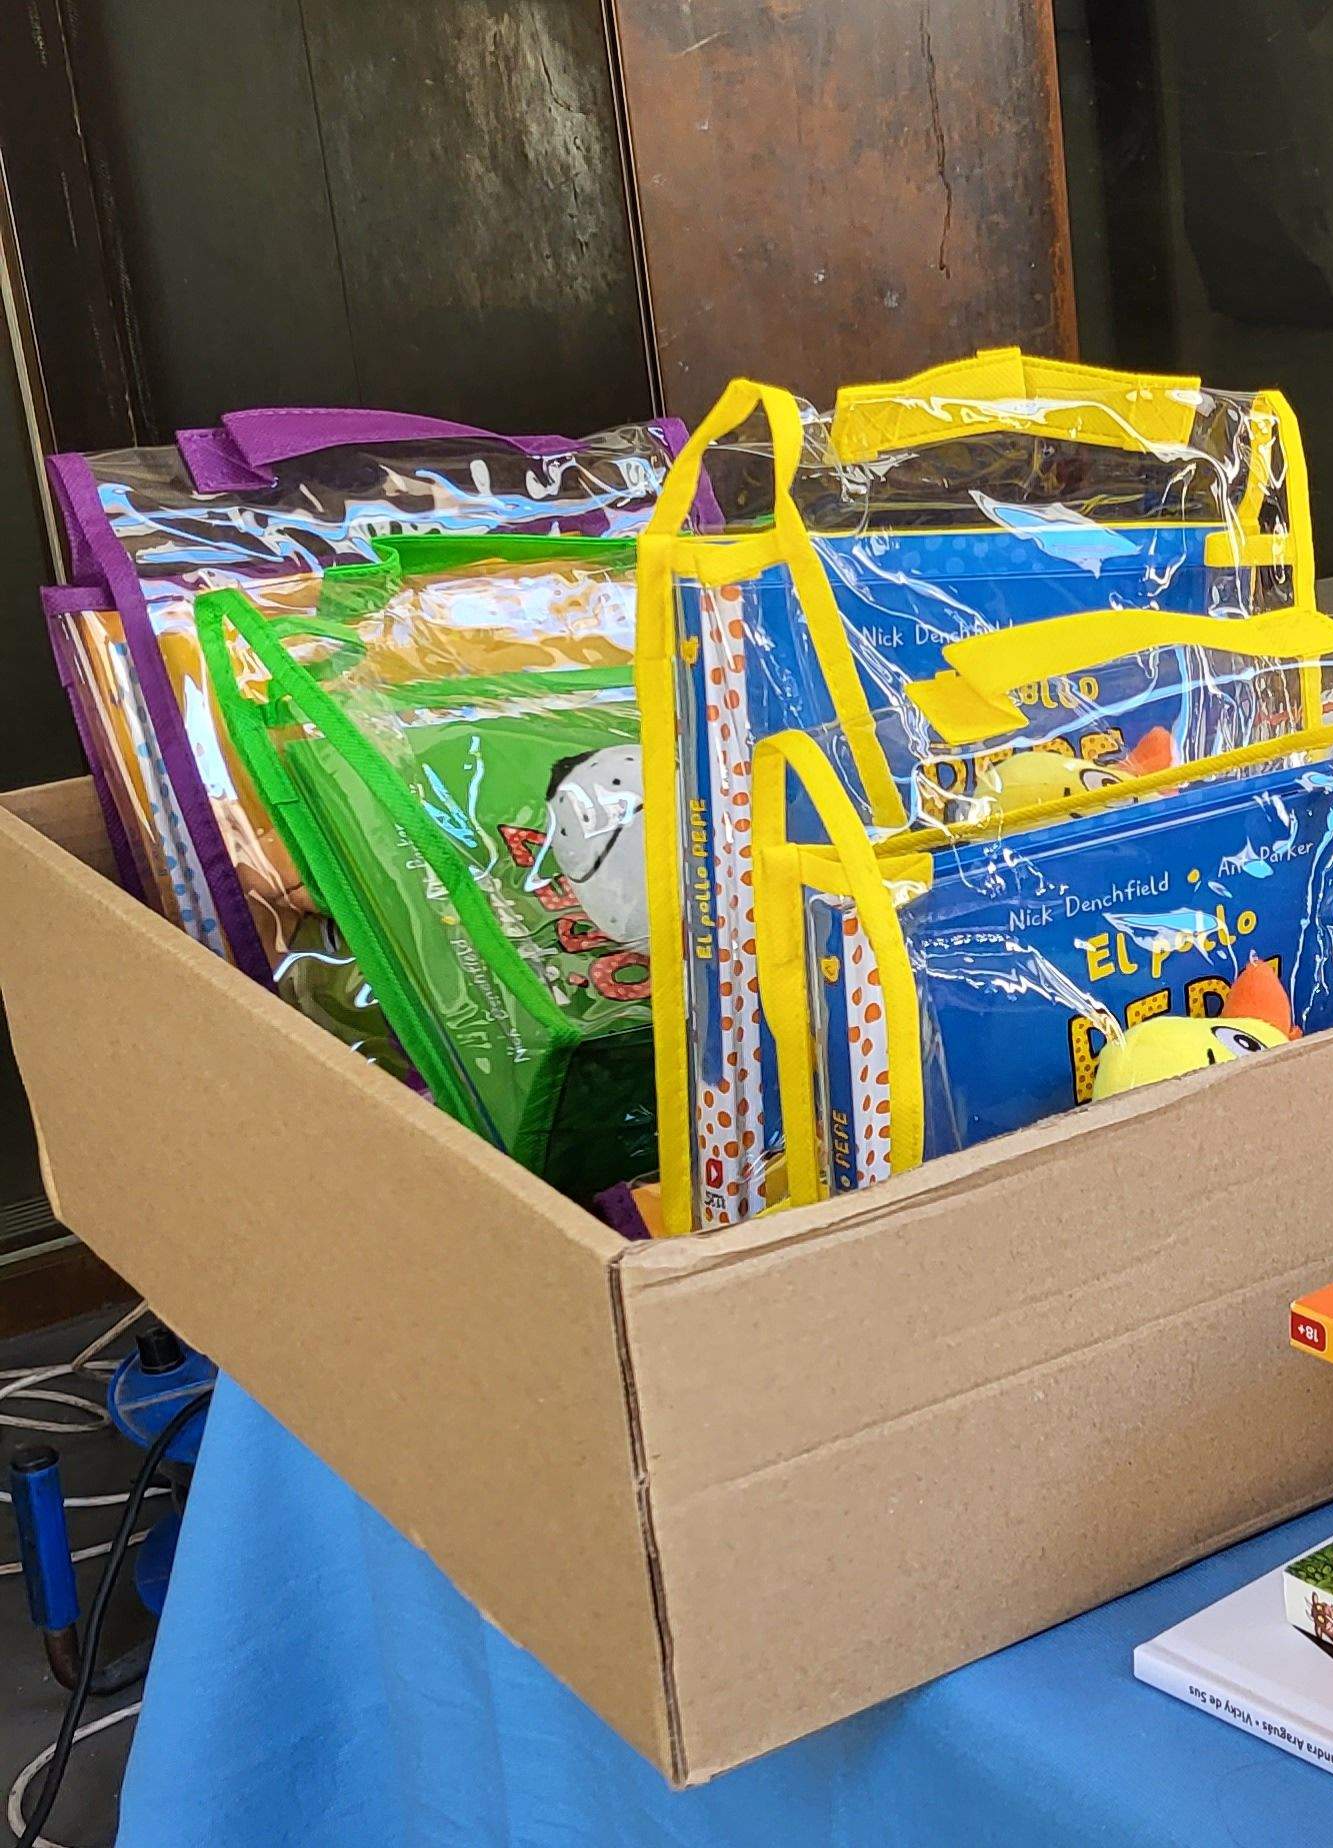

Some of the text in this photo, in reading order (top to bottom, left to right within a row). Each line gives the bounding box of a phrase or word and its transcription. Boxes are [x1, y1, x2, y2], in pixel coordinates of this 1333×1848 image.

[861, 626, 904, 648] Nick
[1260, 841, 1314, 863] Parker
[695, 865, 717, 929] pollo
[1008, 871, 1169, 932] Nick Denchfield
[696, 934, 714, 961] El
[1151, 904, 1257, 979] pollo
[1084, 931, 1138, 982] El
[1187, 1685, 1208, 1704] Sus
[1208, 1694, 1223, 1710] de
[1225, 1701, 1255, 1728] Vicky
[1261, 1723, 1306, 1751] Araguás
